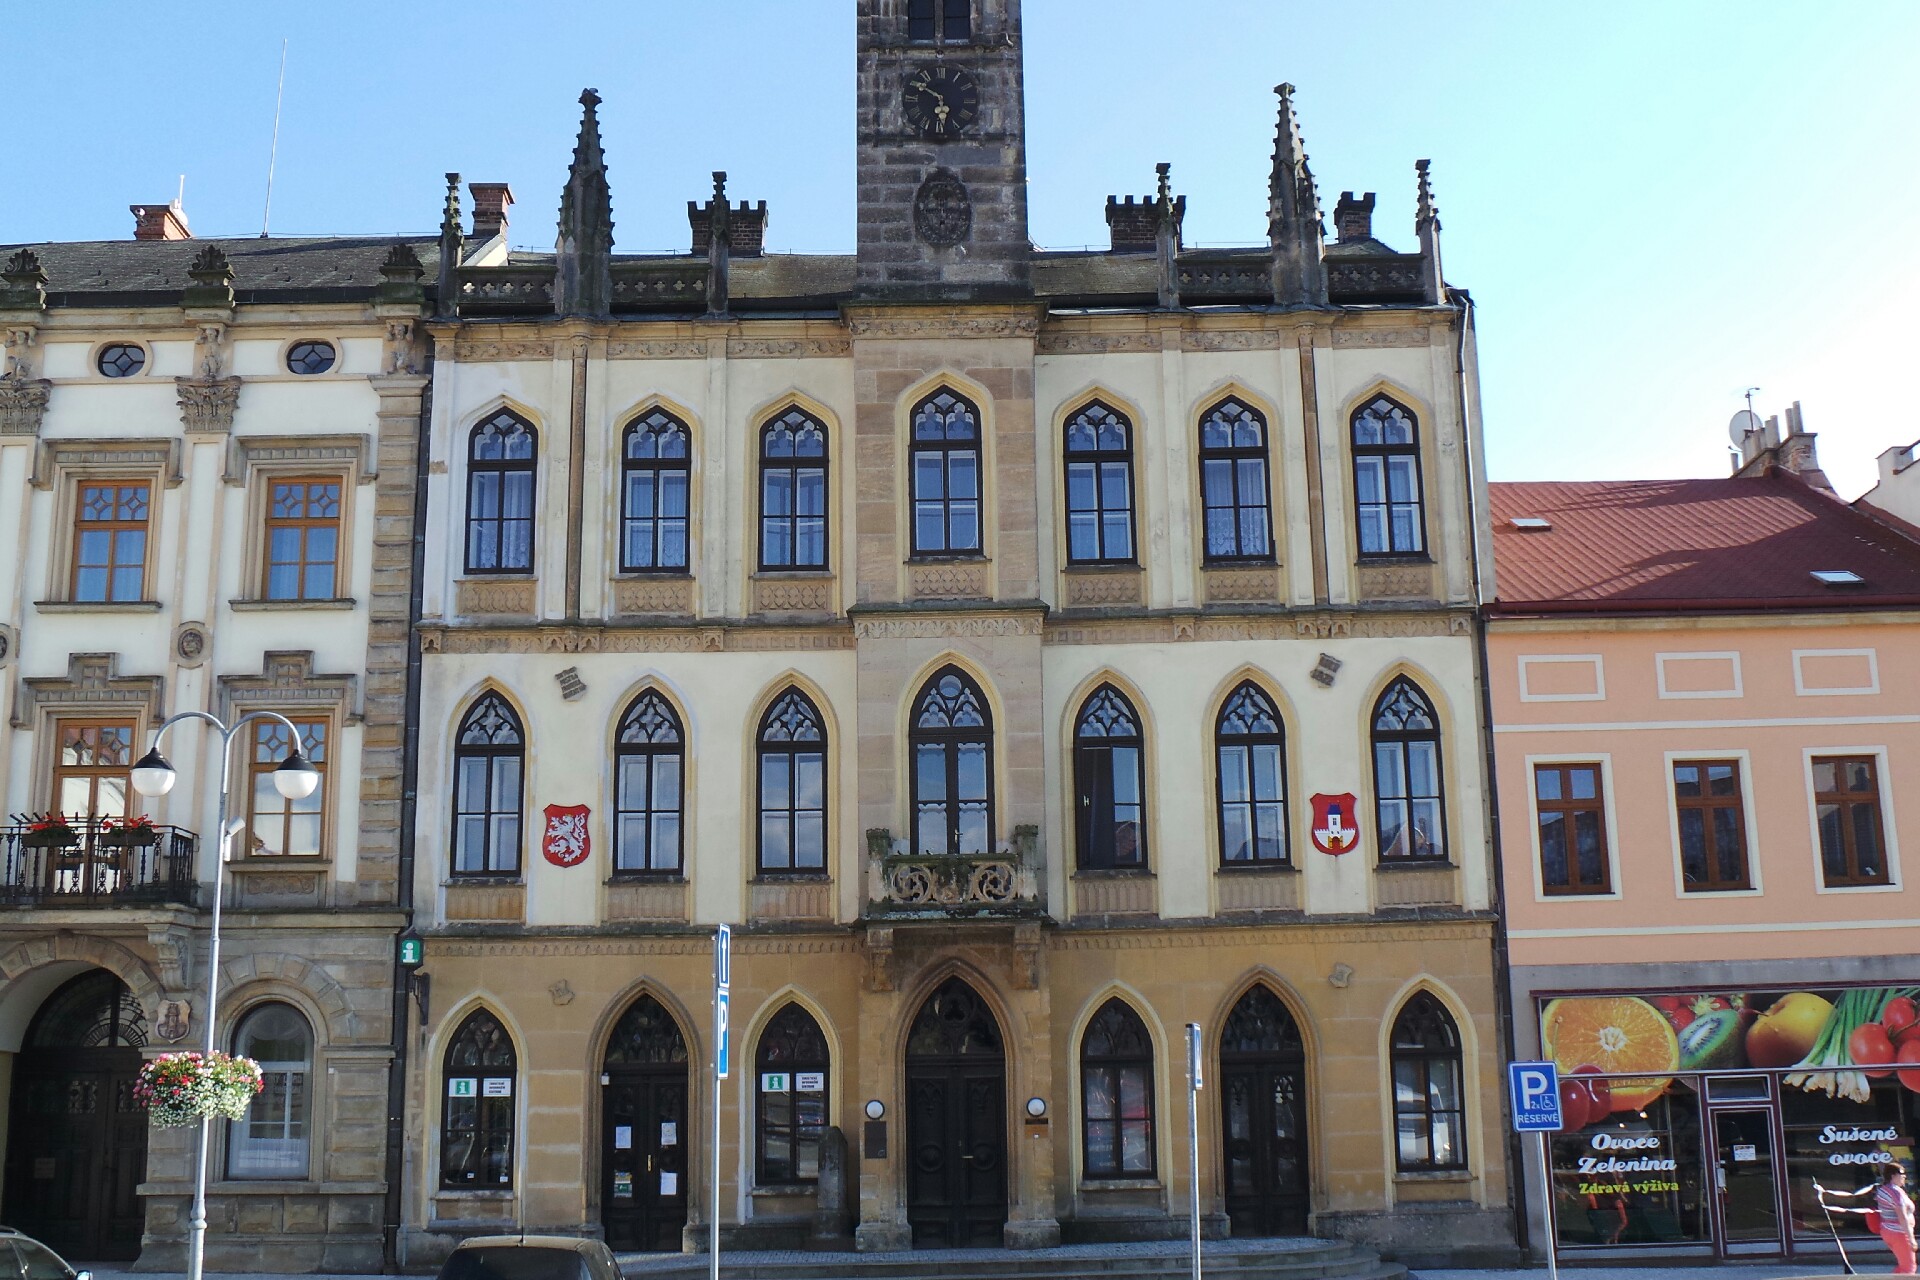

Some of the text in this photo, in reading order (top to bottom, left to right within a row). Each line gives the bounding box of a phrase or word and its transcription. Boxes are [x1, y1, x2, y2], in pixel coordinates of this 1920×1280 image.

[720, 1000, 727, 1050] P
[1520, 1071, 1548, 1110] P
[1530, 1100, 1540, 1109] 2x
[1591, 1133, 1660, 1150] Ovoce
[1818, 1125, 1899, 1144] Sušené
[1578, 1156, 1677, 1174] Zelenina
[1829, 1152, 1893, 1166] ovoce
[1579, 1179, 1680, 1194] Zdravá výživa
